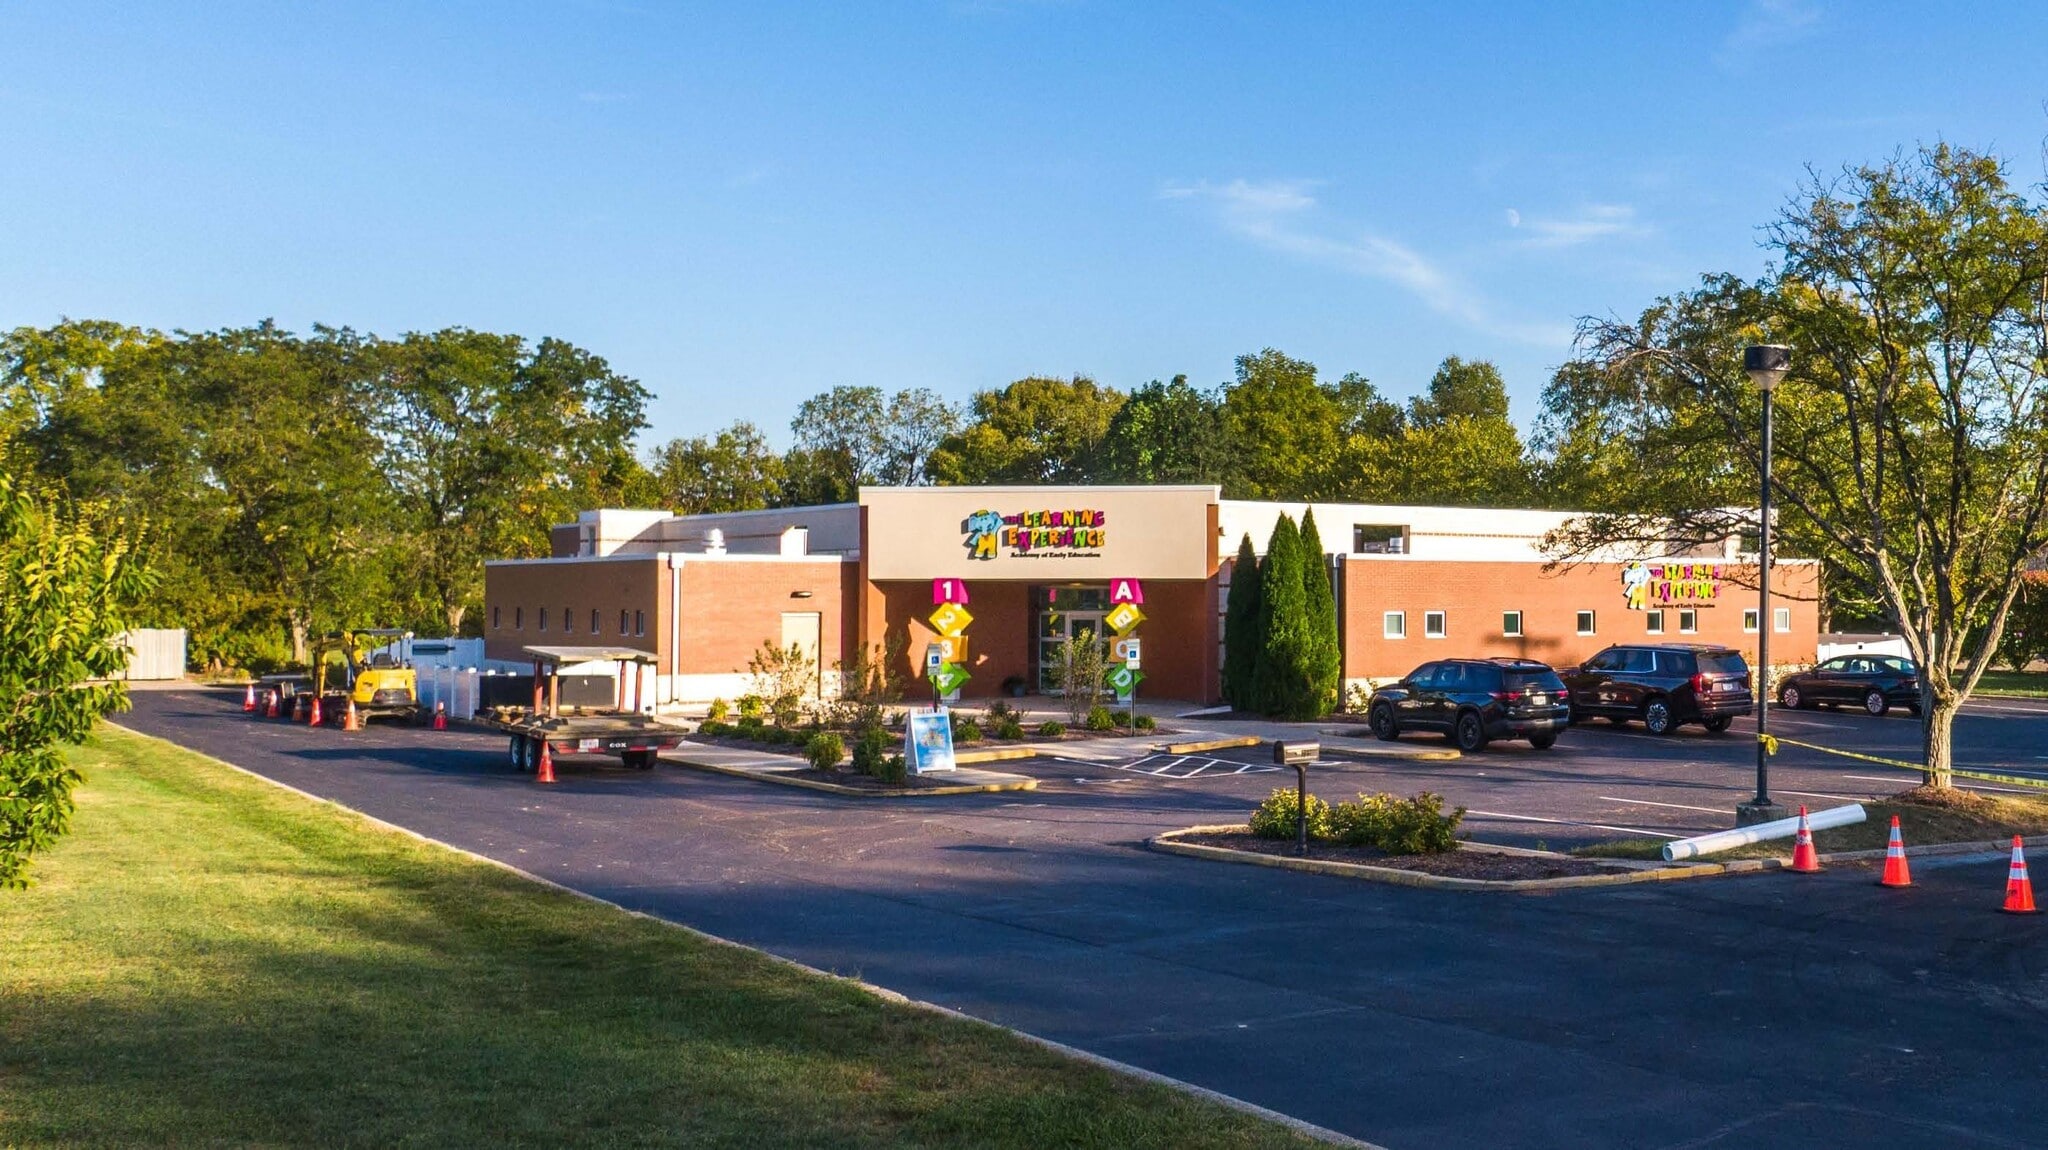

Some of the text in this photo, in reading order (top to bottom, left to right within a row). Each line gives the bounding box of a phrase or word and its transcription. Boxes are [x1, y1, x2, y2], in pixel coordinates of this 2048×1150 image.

[1023, 509, 1105, 527] LEARNING
[1008, 527, 1105, 551] EXPERIENCE
[942, 581, 952, 600] 1
[1115, 581, 1133, 600] A
[937, 611, 956, 630] 2
[1113, 609, 1133, 628] B
[941, 640, 953, 658] 3
[1113, 668, 1132, 687] D
